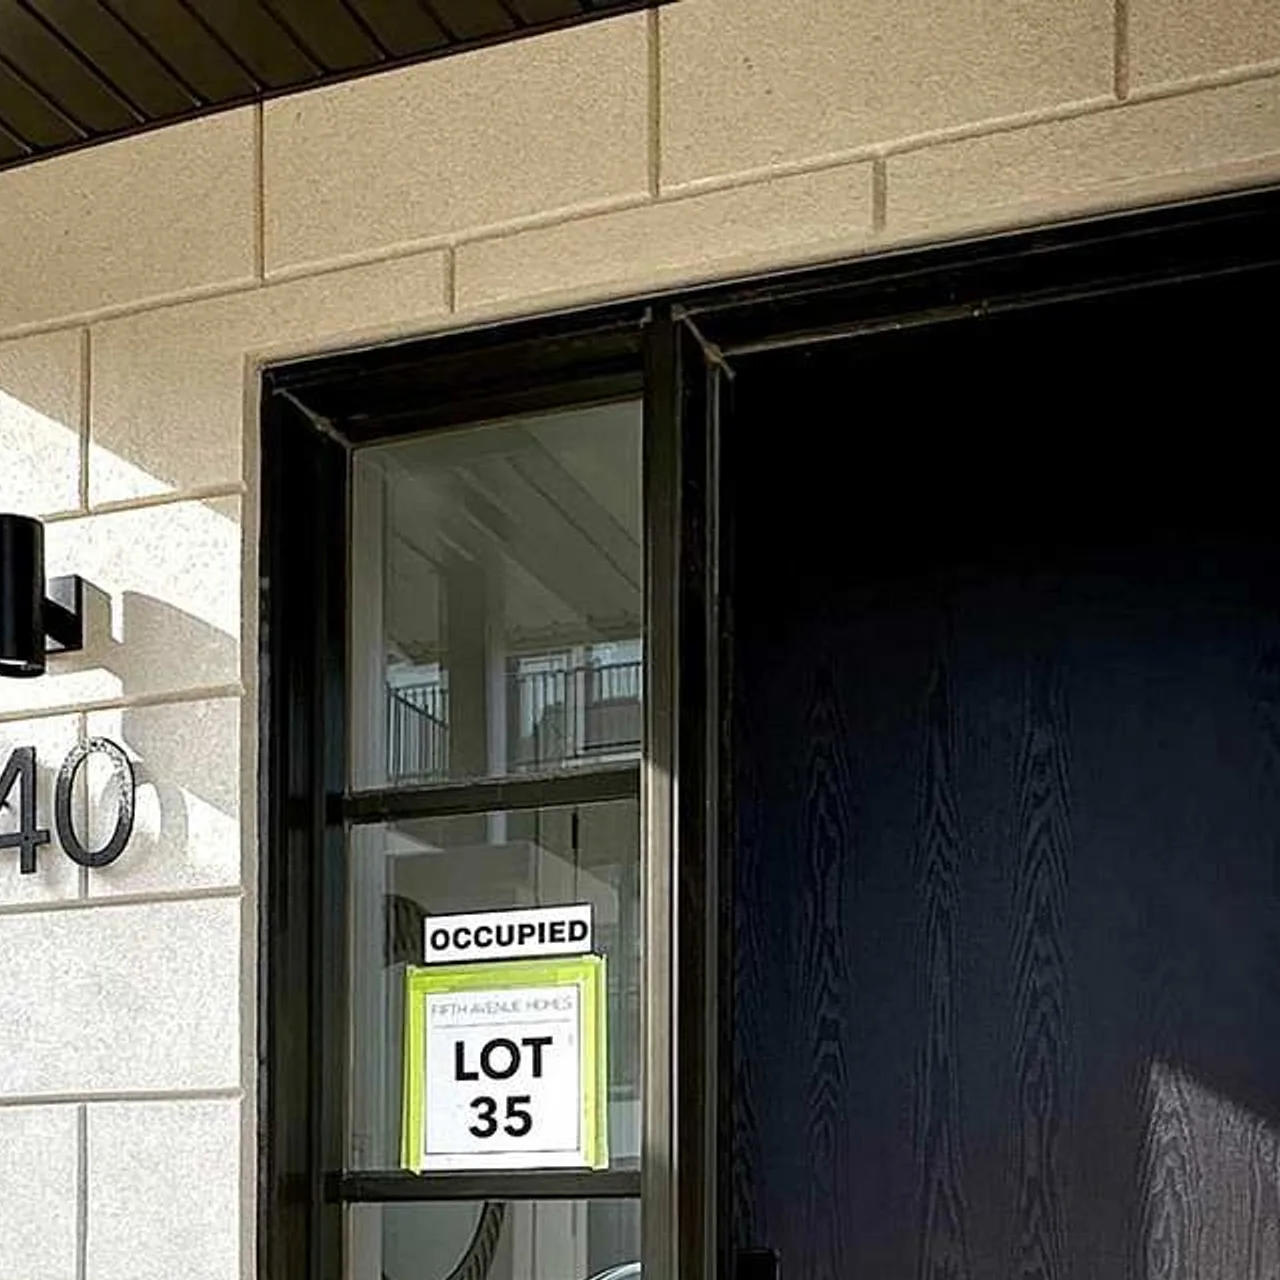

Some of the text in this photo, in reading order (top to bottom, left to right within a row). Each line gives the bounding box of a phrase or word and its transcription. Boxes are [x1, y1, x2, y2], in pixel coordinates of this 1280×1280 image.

[430, 919, 589, 951] OCCUPIED
[454, 1035, 554, 1082] LOT
[469, 1095, 533, 1139] 35
